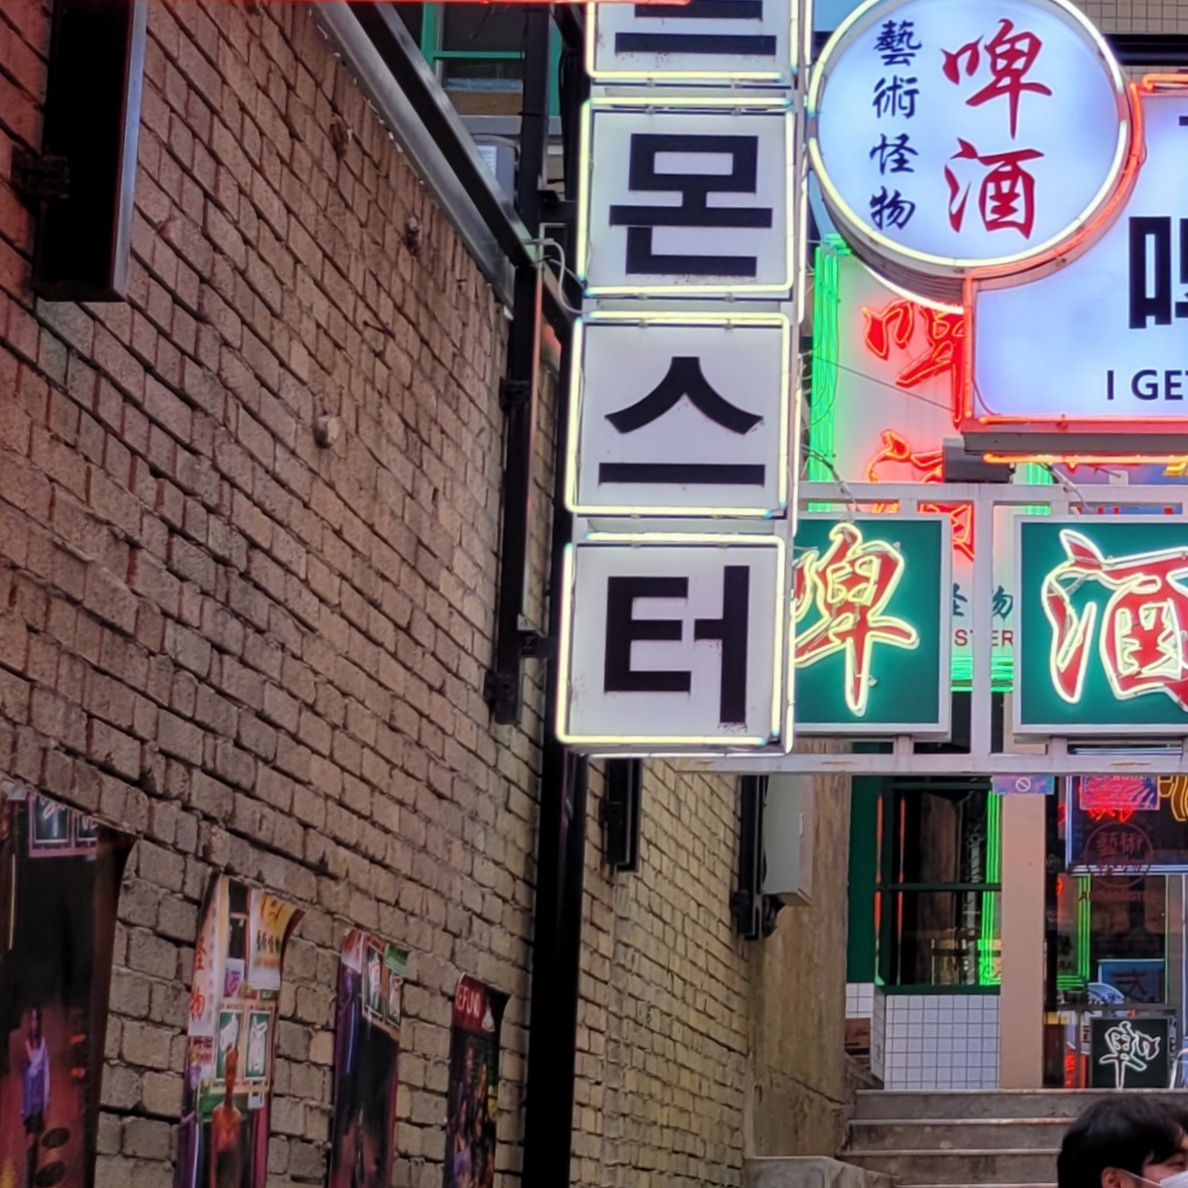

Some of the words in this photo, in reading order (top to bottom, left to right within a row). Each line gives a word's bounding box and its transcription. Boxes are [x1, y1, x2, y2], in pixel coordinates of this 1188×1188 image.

[868, 19, 923, 232] 藝術怪物
[940, 17, 1053, 240] 啤酒
[1106, 369, 1115, 401] I
